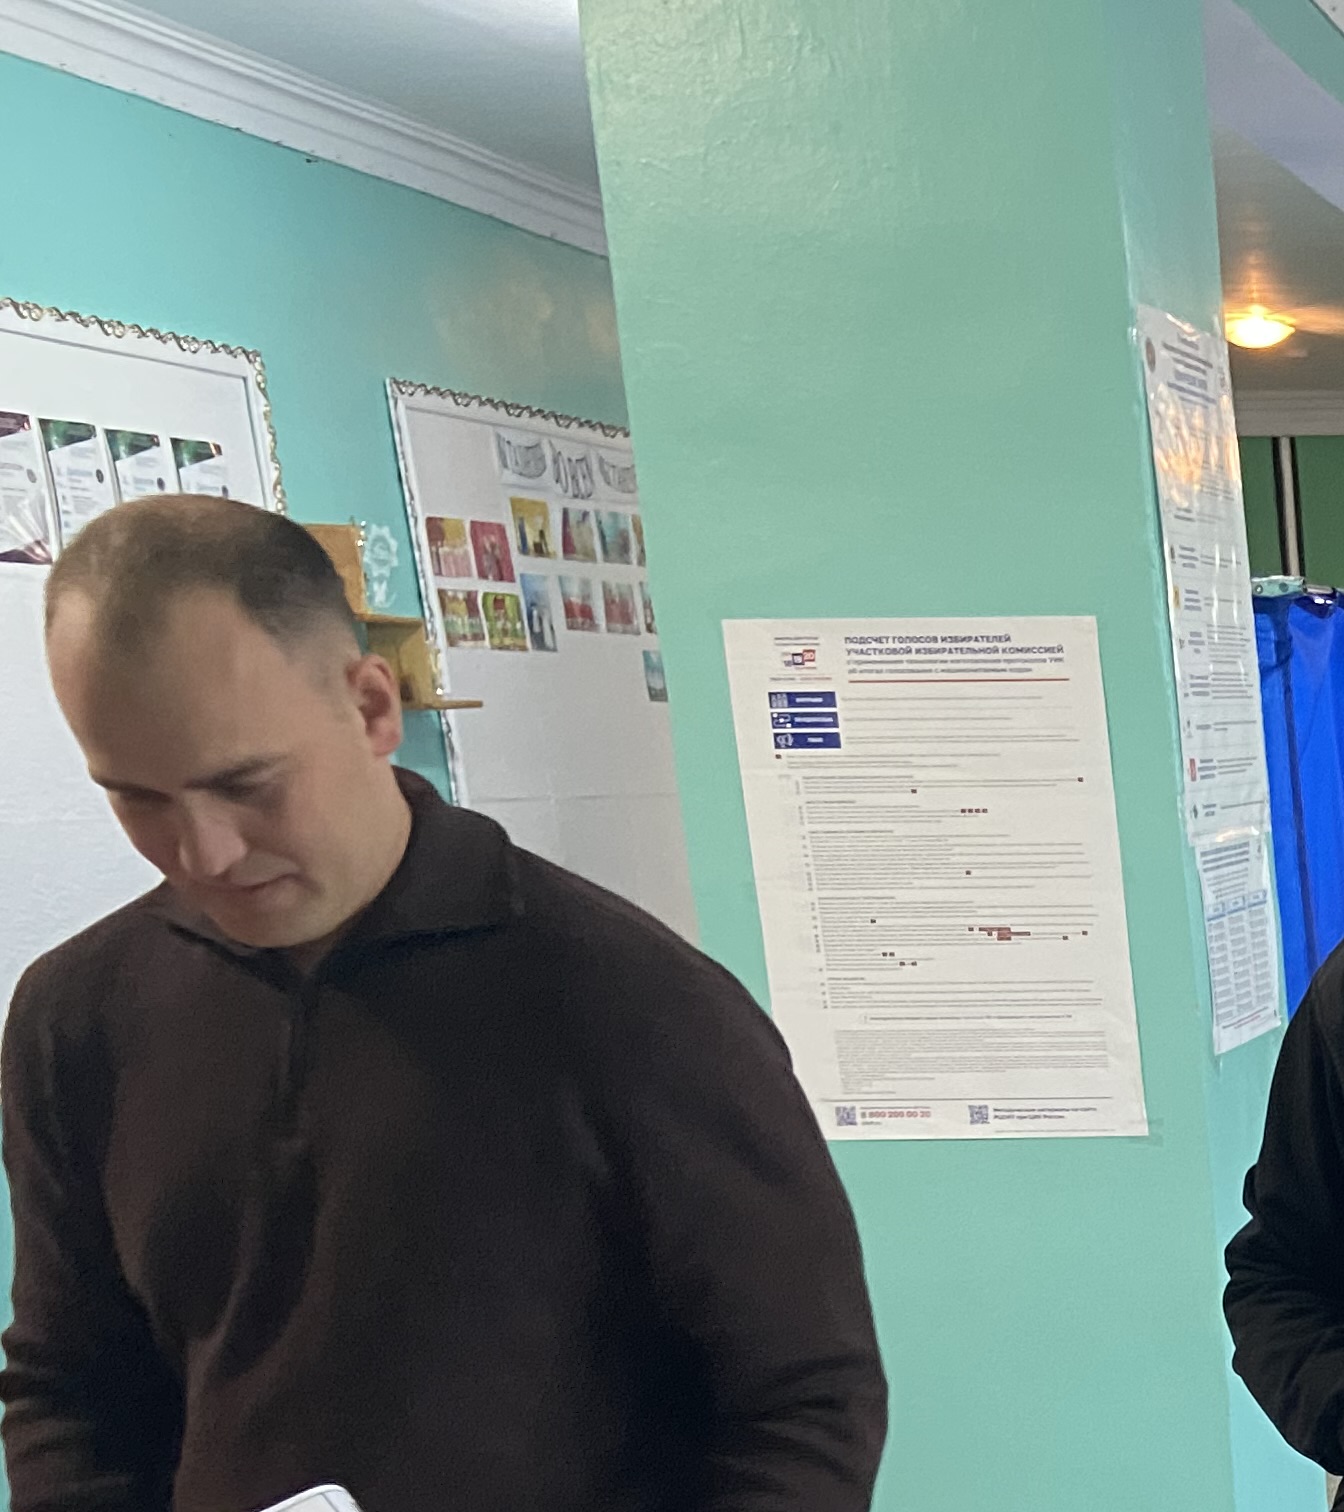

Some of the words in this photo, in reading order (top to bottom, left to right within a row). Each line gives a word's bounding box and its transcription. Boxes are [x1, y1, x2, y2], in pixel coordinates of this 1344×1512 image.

[844, 635, 890, 645] ПОДСЧЕТ
[892, 635, 938, 644] ГОЛОСОВ
[940, 633, 1011, 644] ИЗБИРАТЕЛЕЙ
[846, 645, 912, 656] УЧАСТКОВОЙ
[914, 644, 999, 655] ИЗБИРАТЕЛЬНОЙ
[1001, 643, 1064, 654] КОМИССИЕЙ
